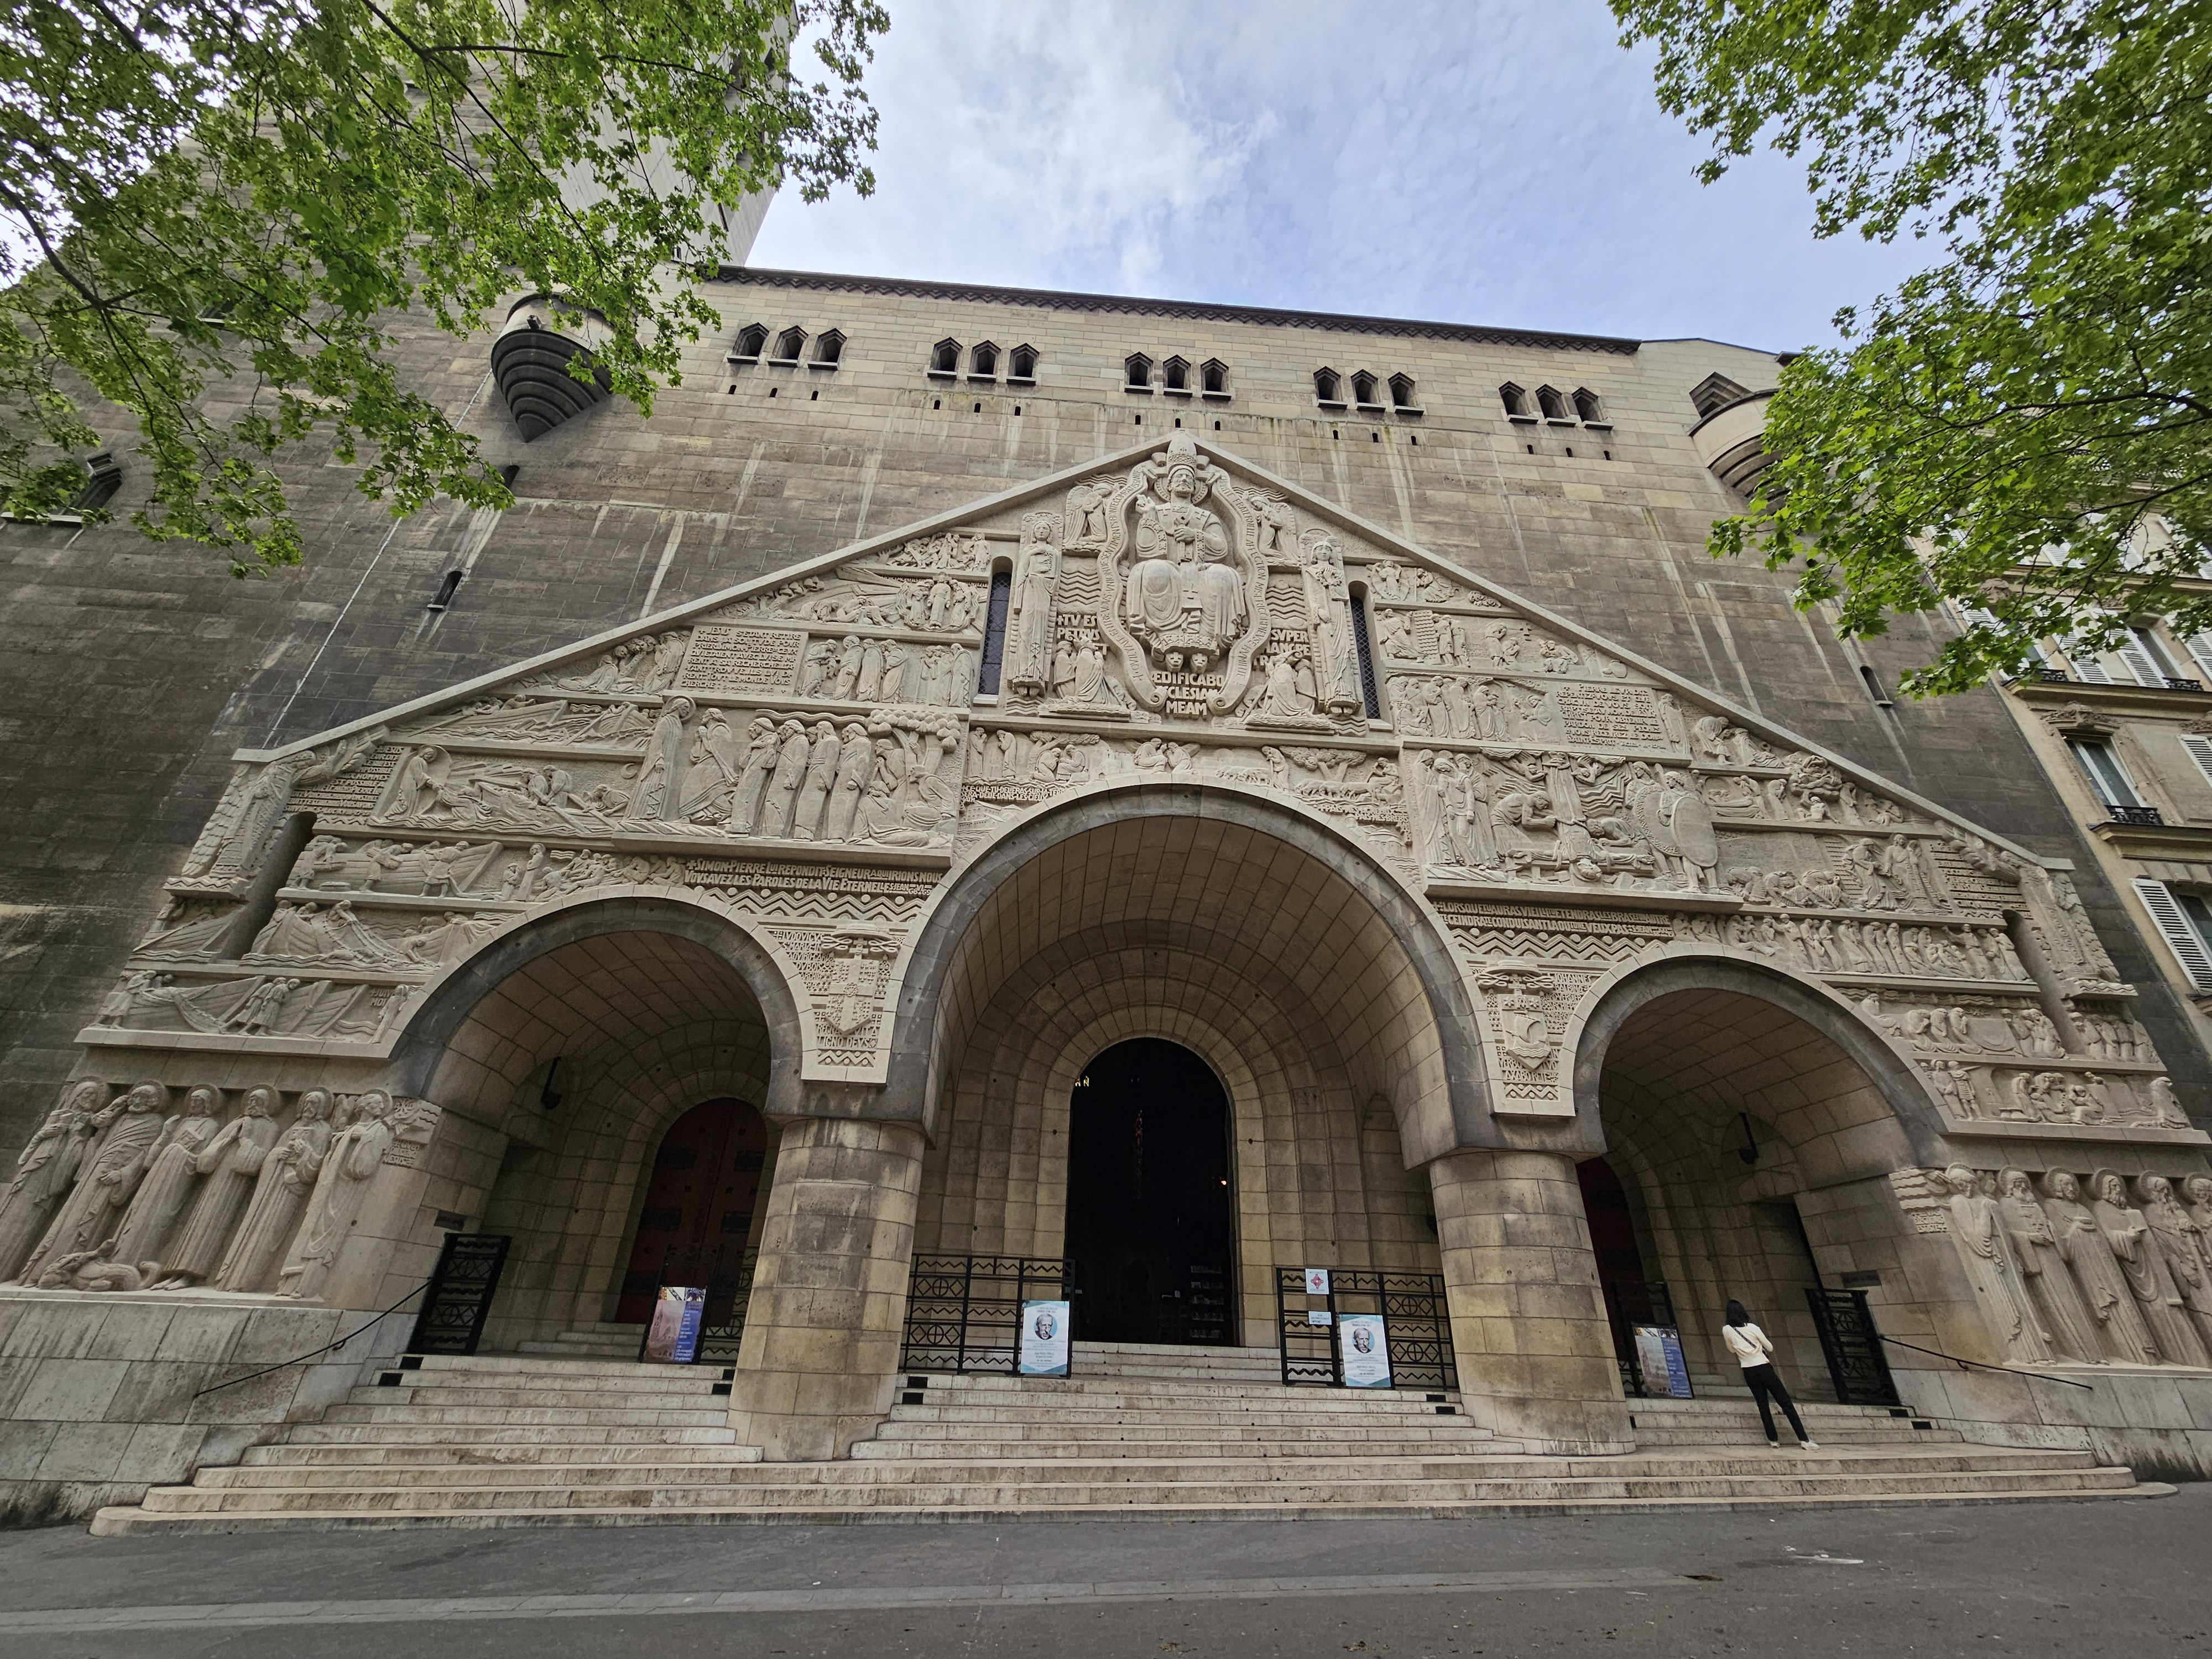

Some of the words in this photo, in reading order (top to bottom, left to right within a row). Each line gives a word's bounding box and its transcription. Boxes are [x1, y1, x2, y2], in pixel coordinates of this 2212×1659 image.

[1245, 539, 1266, 580] AFFECTION
[1063, 614, 1081, 626] TV
[1084, 615, 1098, 627] ES
[1271, 629, 1310, 643] SVPER
[680, 681, 716, 689] CHERCHE
[739, 676, 769, 685] MONDE
[1166, 701, 1208, 716] MEAM
[707, 873, 734, 885] AVEZ
[733, 874, 752, 886] LES
[752, 874, 796, 888] PAROLES
[796, 878, 809, 889] DE
[808, 878, 822, 889] LA
[822, 877, 842, 890] VIE
[825, 865, 873, 880] SEIGNEUR
[888, 870, 920, 882] IRIONS
[919, 872, 943, 884] NOUS
[1491, 905, 1521, 916] AURAS
[1556, 907, 1601, 921] ETENDRAS
[1611, 912, 1634, 923] BRAS
[1586, 922, 1611, 934] VEUX
[1611, 924, 1629, 935] PAS
